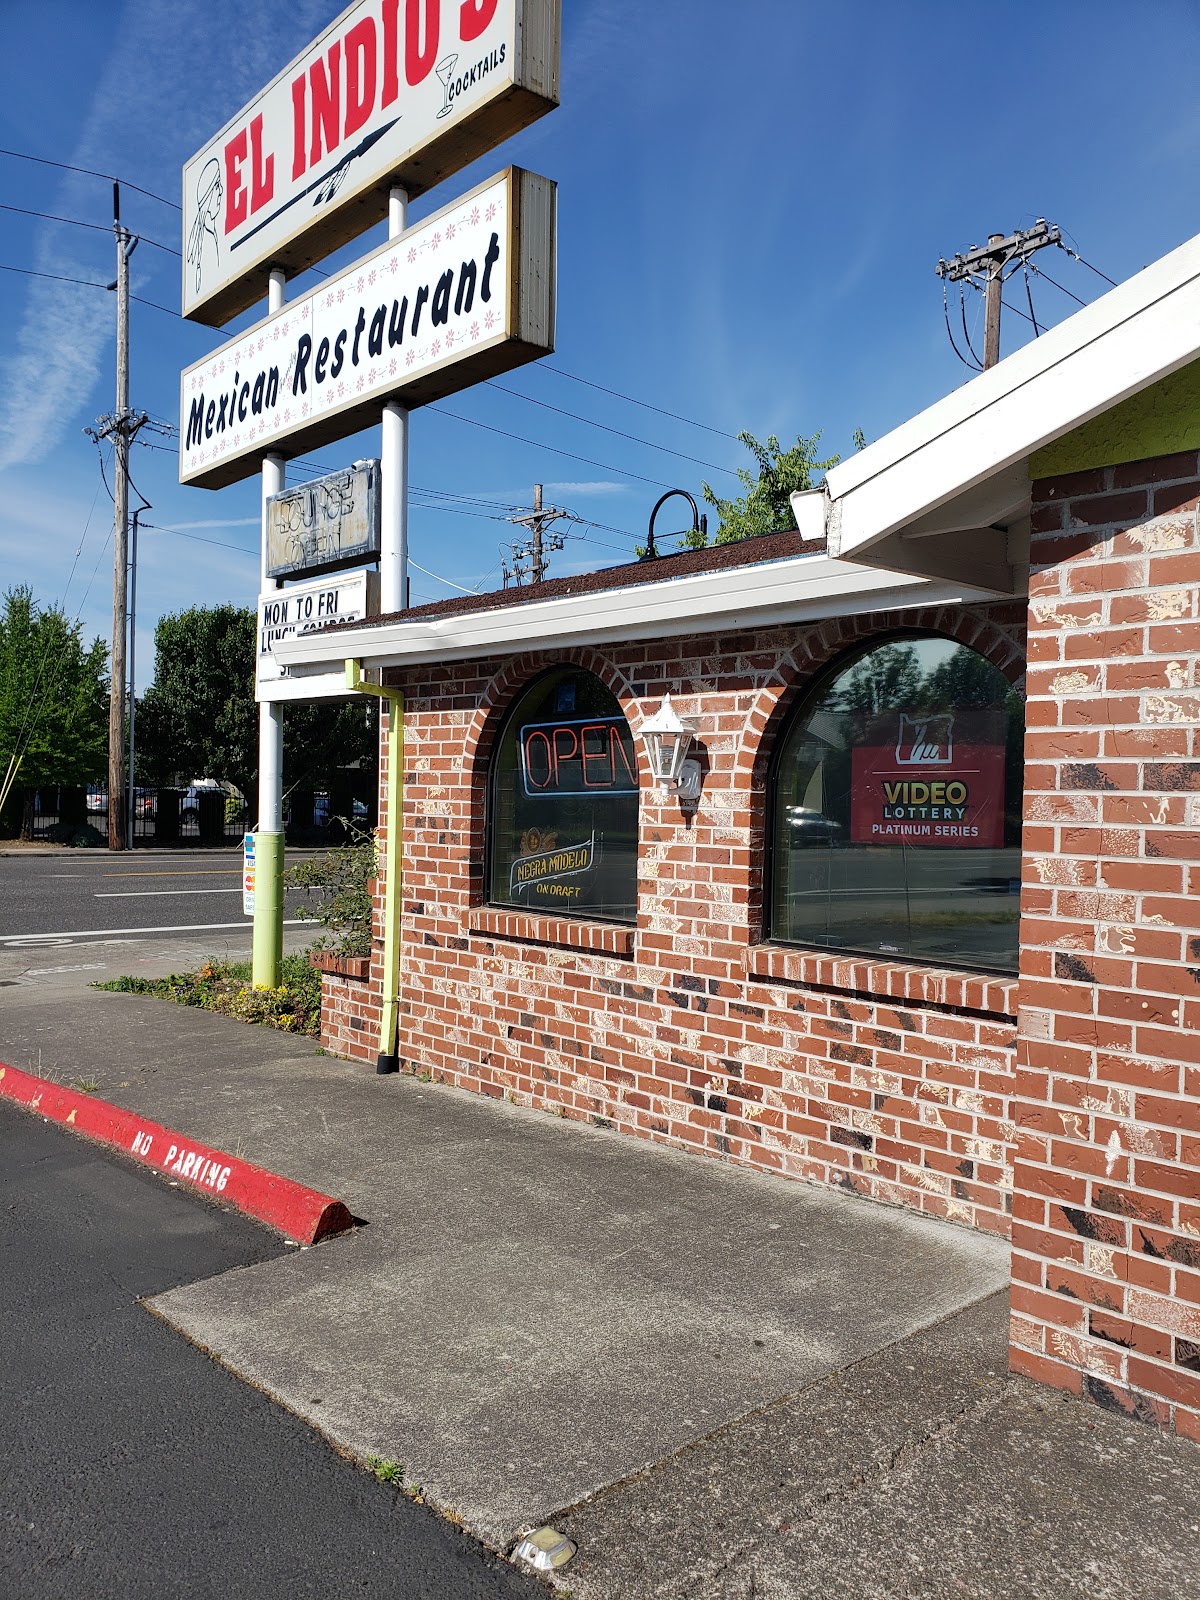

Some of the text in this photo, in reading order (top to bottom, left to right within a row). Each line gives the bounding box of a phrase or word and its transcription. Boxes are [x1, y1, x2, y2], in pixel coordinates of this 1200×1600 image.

[448, 43, 506, 102] COCKTAILS
[224, 112, 275, 236] EL
[185, 232, 500, 451] Mexican Restaurant
[264, 601, 288, 627] MON
[296, 596, 313, 620] TO
[318, 590, 339, 616] FRI
[261, 626, 296, 653] LUNC
[525, 724, 640, 788] OPEN
[883, 781, 967, 805] VIDEO
[872, 823, 979, 837] PLATINUM SERIES
[884, 806, 966, 819] LOTTERY
[517, 848, 588, 881] NEGRA MODELO
[536, 883, 581, 898] ON DRAFT
[131, 1130, 231, 1193] NO PARKING
